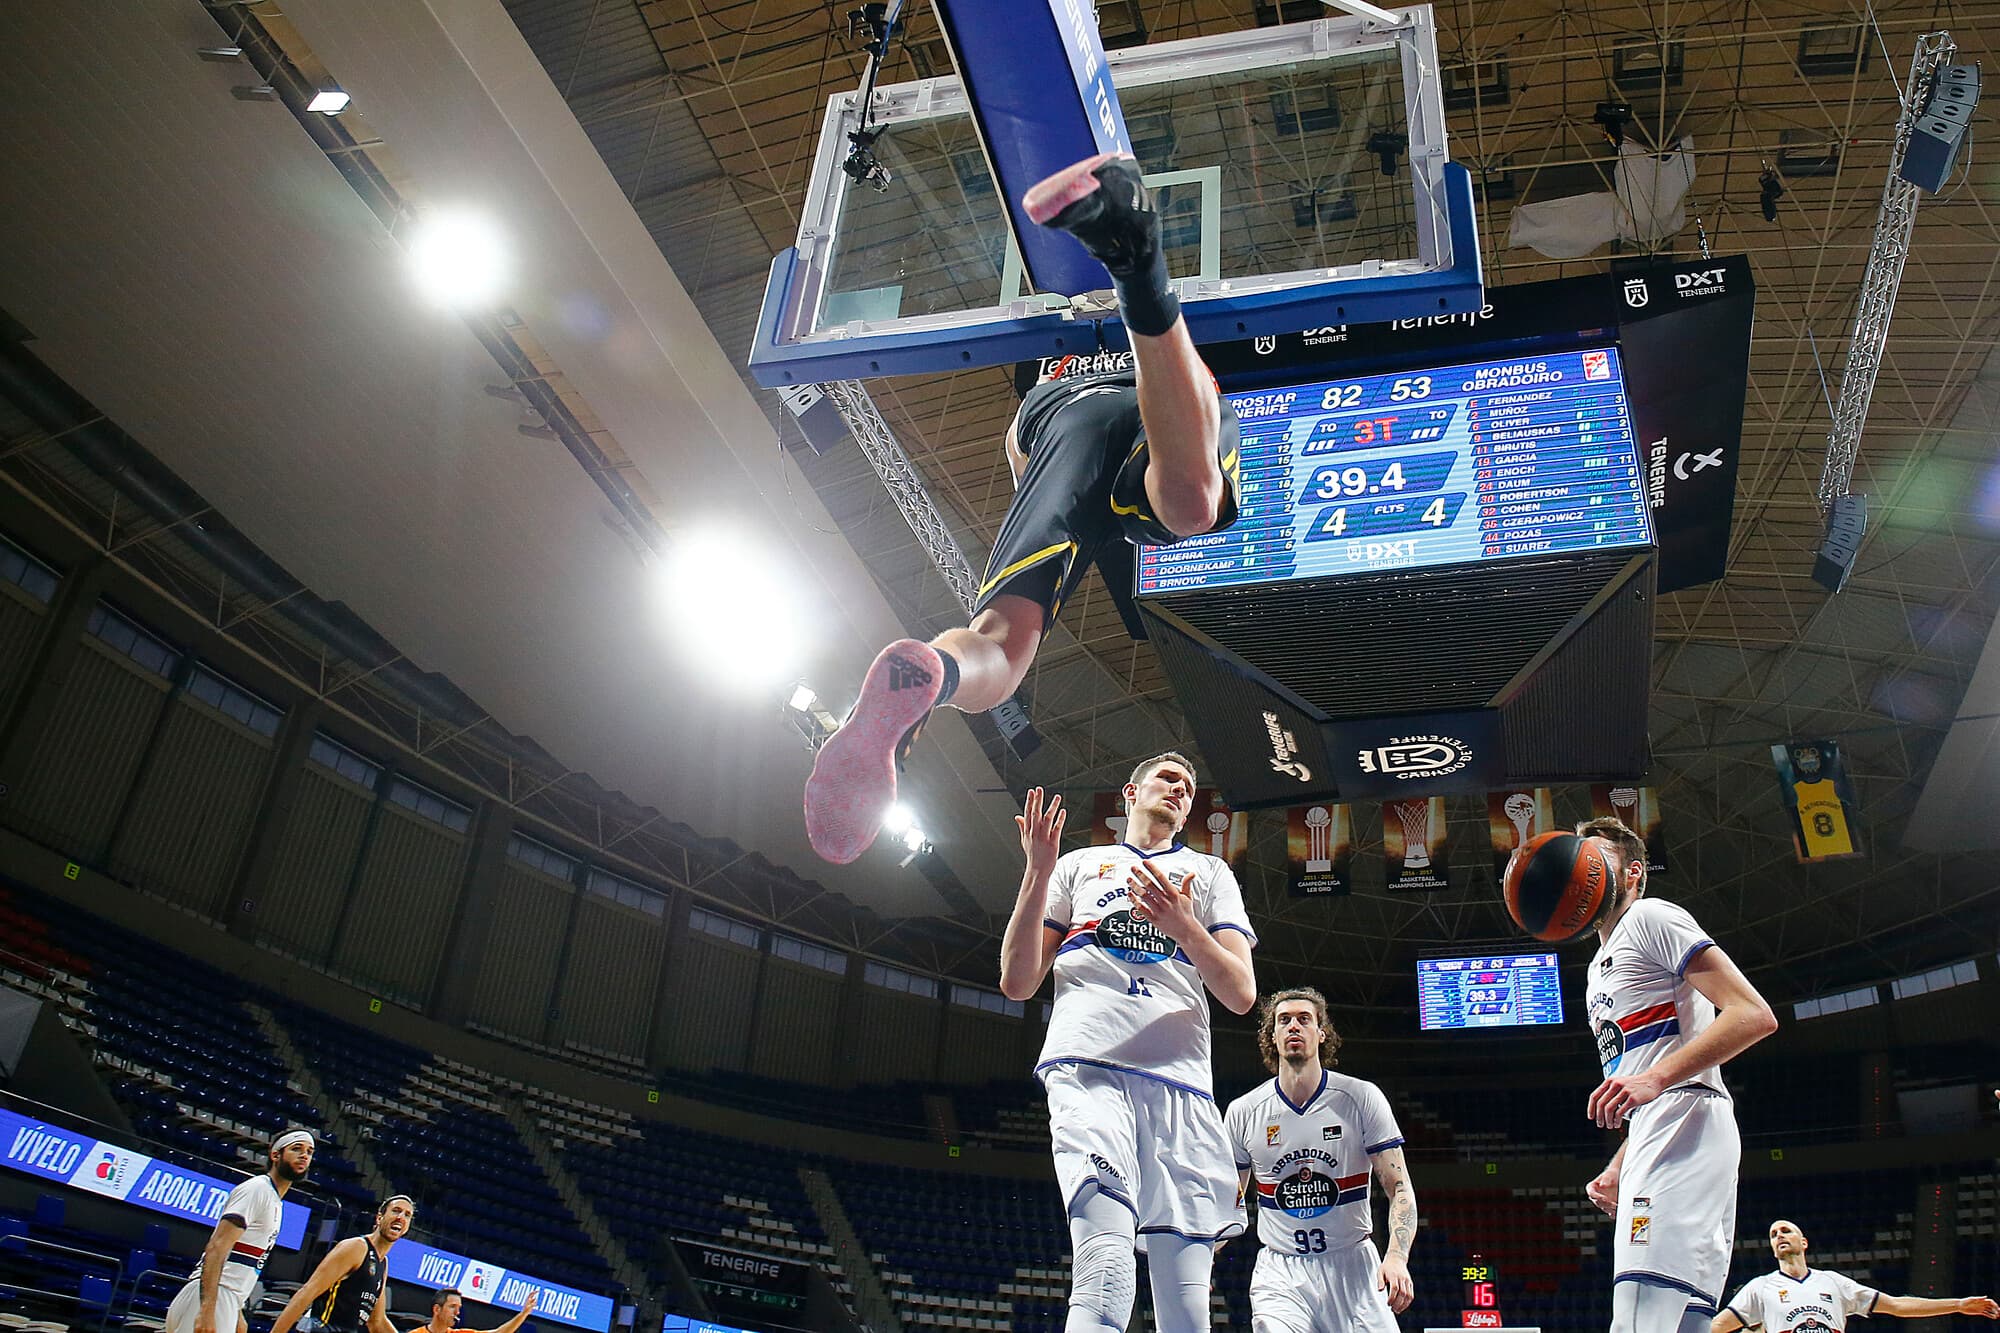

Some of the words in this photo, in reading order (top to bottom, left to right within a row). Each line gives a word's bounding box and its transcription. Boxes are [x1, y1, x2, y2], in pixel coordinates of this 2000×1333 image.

[1064, 0, 1098, 85] ERIFE
[1095, 77, 1117, 139] TOP
[1674, 268, 1727, 289] DXT
[1677, 285, 1726, 298] TENERIFE
[1303, 334, 1348, 346] TENERIFE
[1475, 361, 1548, 379] MONBUS
[1461, 371, 1563, 392] OBRADOIRO
[1230, 393, 1297, 409] ROSTAR
[1320, 384, 1363, 410] 82
[1389, 376, 1432, 401] 53
[1487, 391, 1553, 406] FERNANDEZ
[1235, 403, 1290, 419] NERIFE
[1428, 410, 1447, 420] TO
[1470, 411, 1479, 419] 2
[1489, 405, 1529, 418] MUÑOZ
[1615, 395, 1622, 404] 3
[1472, 422, 1480, 431] 6
[1491, 417, 1530, 429] OLIVER
[1617, 406, 1624, 416] 3
[1319, 423, 1338, 433] TO
[1353, 416, 1399, 443] 3T
[1473, 434, 1481, 443] 9
[1492, 427, 1561, 441] BELIAUSKAS
[1618, 419, 1626, 428] 2
[1277, 444, 1290, 453] 12
[1476, 446, 1488, 454] 11
[1493, 440, 1536, 453] BIRUTIS
[1620, 430, 1628, 439] 3
[1277, 456, 1290, 465] 15
[1477, 457, 1490, 466] 19
[1494, 452, 1537, 465] GARCIA
[1478, 469, 1493, 479] 23
[1496, 465, 1536, 477] ENOCH
[1619, 455, 1632, 464] 11
[1315, 463, 1407, 499] 39.4
[1650, 436, 1668, 509] TENERIFE
[1479, 482, 1493, 491] 24
[1498, 478, 1531, 490] DAUM
[1480, 495, 1494, 504] 30
[1499, 487, 1569, 501] ROBERTSON
[1321, 507, 1347, 536] 4
[1374, 503, 1405, 515] FLTS
[1420, 497, 1446, 526] 4
[1481, 507, 1496, 516] 32
[1500, 503, 1541, 514] COHEN
[1502, 512, 1585, 527] CZERAPOWICZ
[1279, 528, 1292, 537] 15
[1504, 529, 1542, 540] POZAS
[1505, 541, 1552, 553] SUAREZ
[1159, 552, 1204, 563] GUERRA
[1159, 560, 1235, 575] DOORNEKAMP
[1159, 576, 1207, 588] BRNOVIC
[1262, 711, 1290, 761] TENERIFE
[1389, 735, 1469, 750] TENERIFE
[1459, 751, 1473, 761] DE
[1396, 762, 1466, 779] CABILDO
[1812, 812, 1836, 837] 8
[1109, 932, 1164, 953] Galicia
[1470, 960, 1483, 969] 82
[1490, 959, 1504, 968] 53
[1469, 990, 1497, 1001] 39.3
[1471, 1005, 1480, 1015] 4
[1499, 1003, 1509, 1013] 4
[1272, 1149, 1338, 1175] OBRADOIRO
[7, 1125, 84, 1175] VÍVELO
[138, 1169, 230, 1220] ARONA.TR
[1282, 1180, 1330, 1195] Estrella
[1285, 1194, 1329, 1208] Galicia
[1294, 1228, 1328, 1255] 93
[416, 1252, 463, 1287] VÍVELO
[703, 1251, 780, 1278] TENERIFE
[1473, 1283, 1495, 1307] 16
[1786, 1305, 1833, 1322] OBRADOIRO
